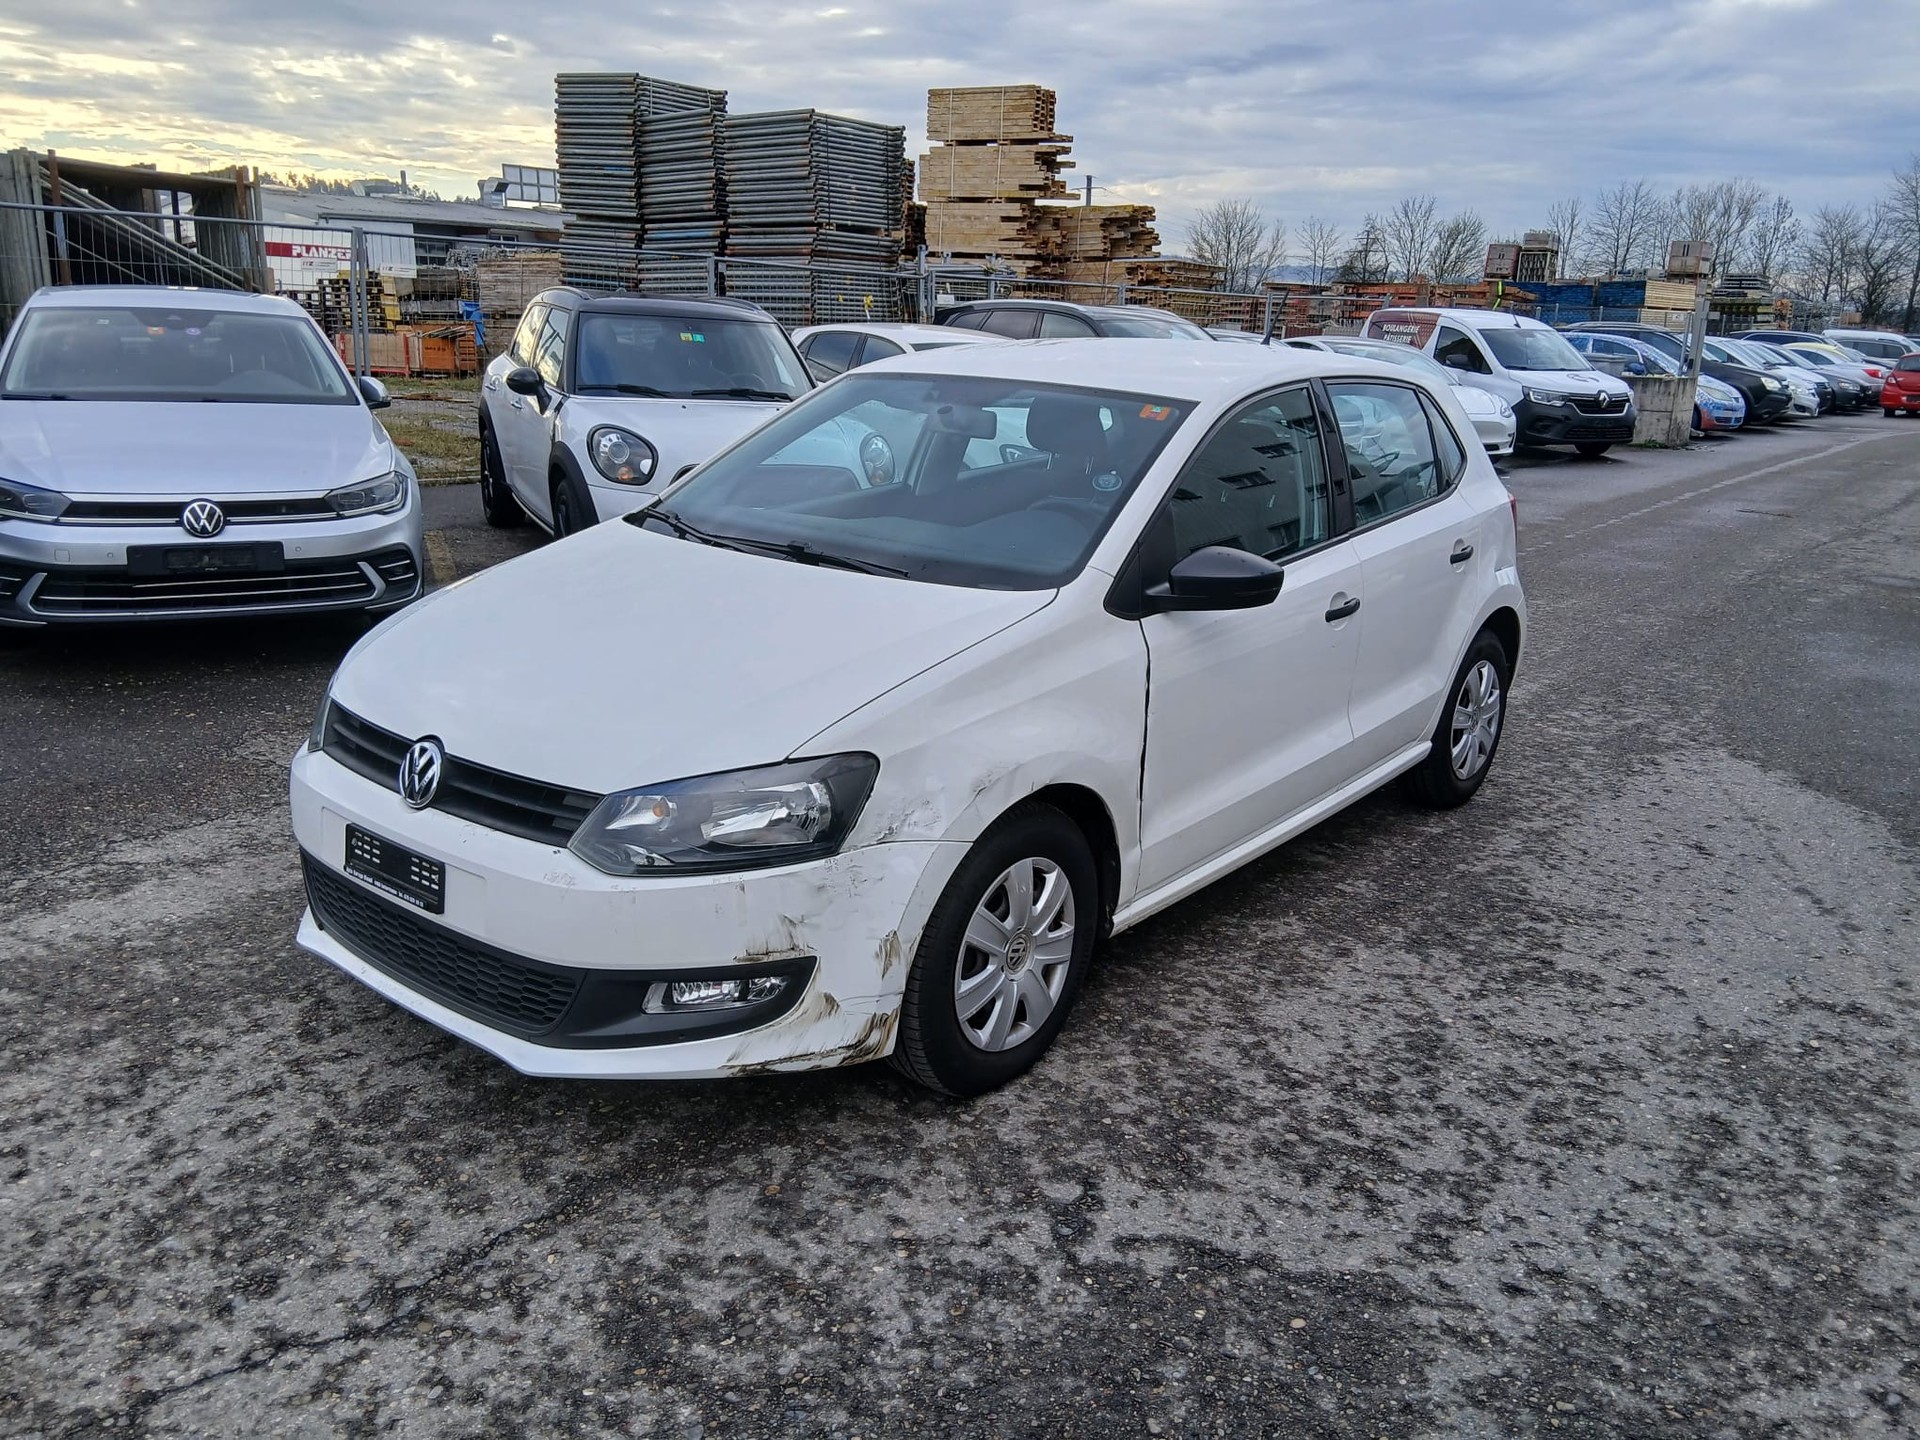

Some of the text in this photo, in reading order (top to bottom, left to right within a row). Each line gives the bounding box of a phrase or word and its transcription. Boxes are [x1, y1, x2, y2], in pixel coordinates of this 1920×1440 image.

[1382, 323, 1420, 334] BOULANGERIE
[1383, 332, 1412, 344] PÂTISSERIE
[183, 501, 223, 537] VW
[400, 741, 442, 808] VW
